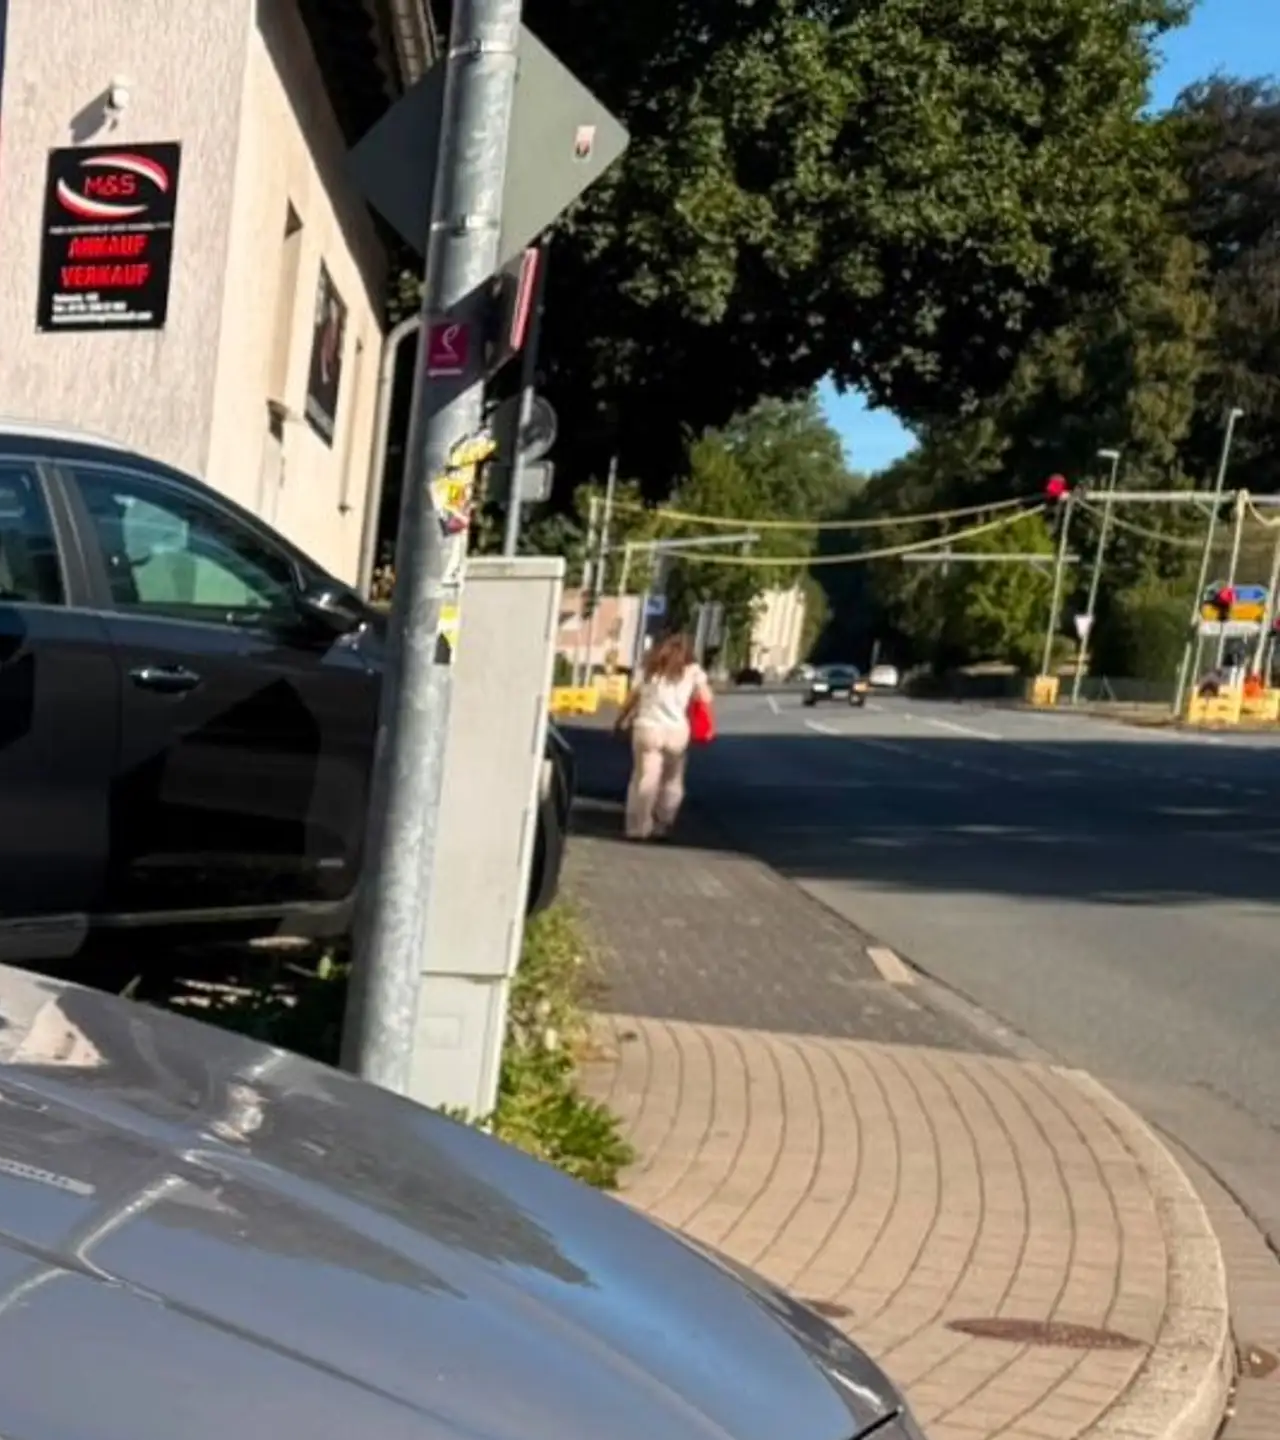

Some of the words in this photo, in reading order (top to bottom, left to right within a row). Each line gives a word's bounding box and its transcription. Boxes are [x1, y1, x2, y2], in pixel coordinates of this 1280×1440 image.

[83, 174, 137, 196] M&S
[68, 233, 149, 259] ANKAUF
[60, 262, 151, 288] VERKAUF
